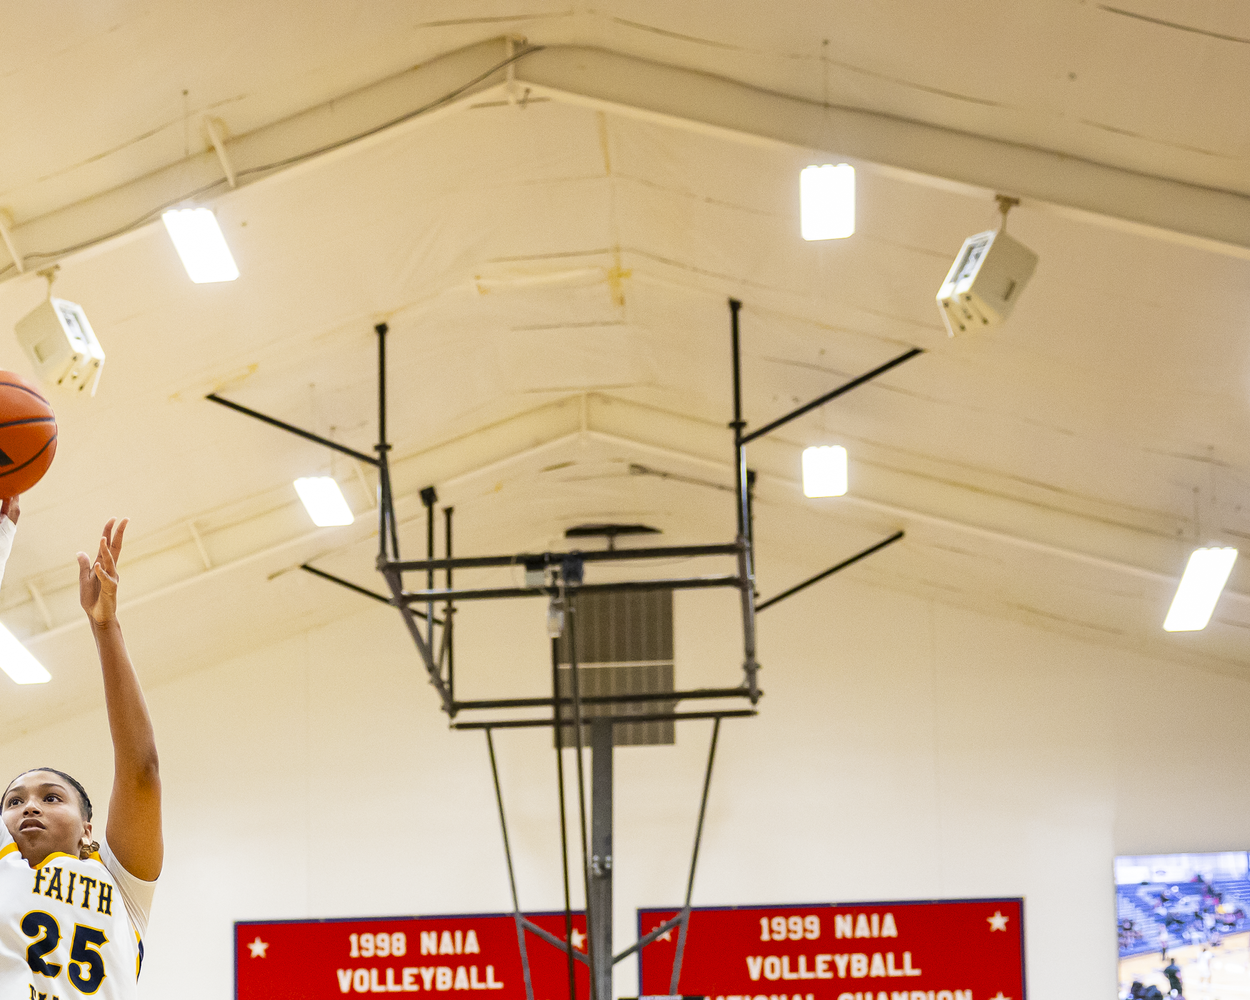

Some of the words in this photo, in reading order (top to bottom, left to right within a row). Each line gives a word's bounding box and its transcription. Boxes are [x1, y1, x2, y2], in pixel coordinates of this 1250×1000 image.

[32, 866, 113, 916] FAITH
[759, 914, 820, 941] 1999
[835, 912, 898, 938] NAIA
[20, 910, 110, 996] 25
[349, 932, 406, 958] 1998
[420, 929, 481, 956] NAIA
[337, 965, 504, 993] VOLLEYBALL
[746, 951, 921, 981] VOLLEYBALL
